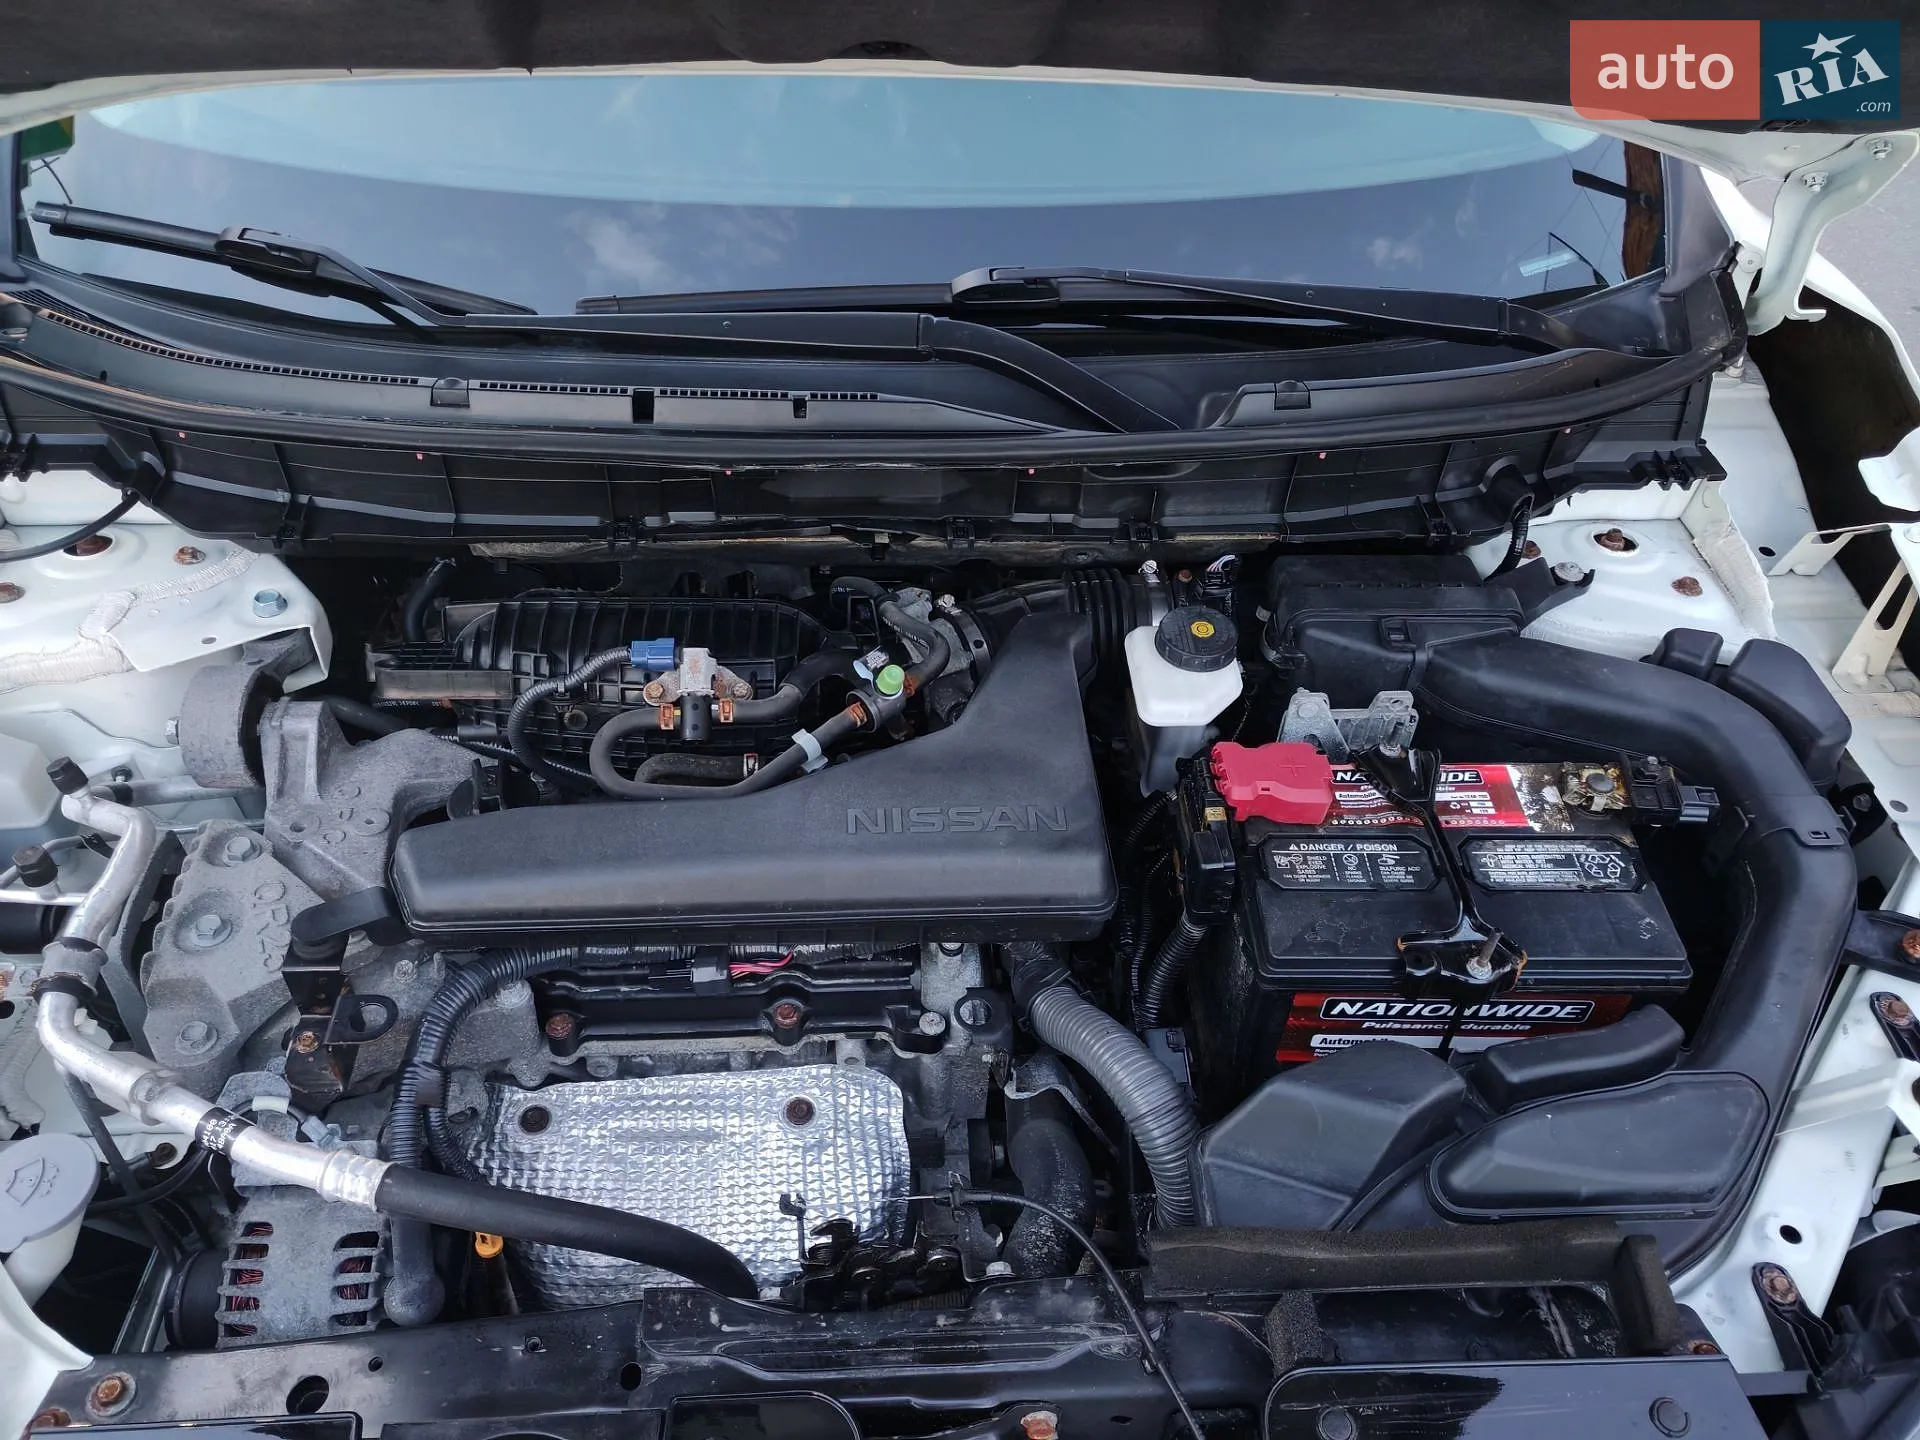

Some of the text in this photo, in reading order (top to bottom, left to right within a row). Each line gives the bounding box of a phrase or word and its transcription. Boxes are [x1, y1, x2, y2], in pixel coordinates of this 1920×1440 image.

[846, 805, 1069, 835] NISSAN
[1300, 843, 1398, 851] DANGER / POISON
[1460, 1021, 1531, 1031] durable
